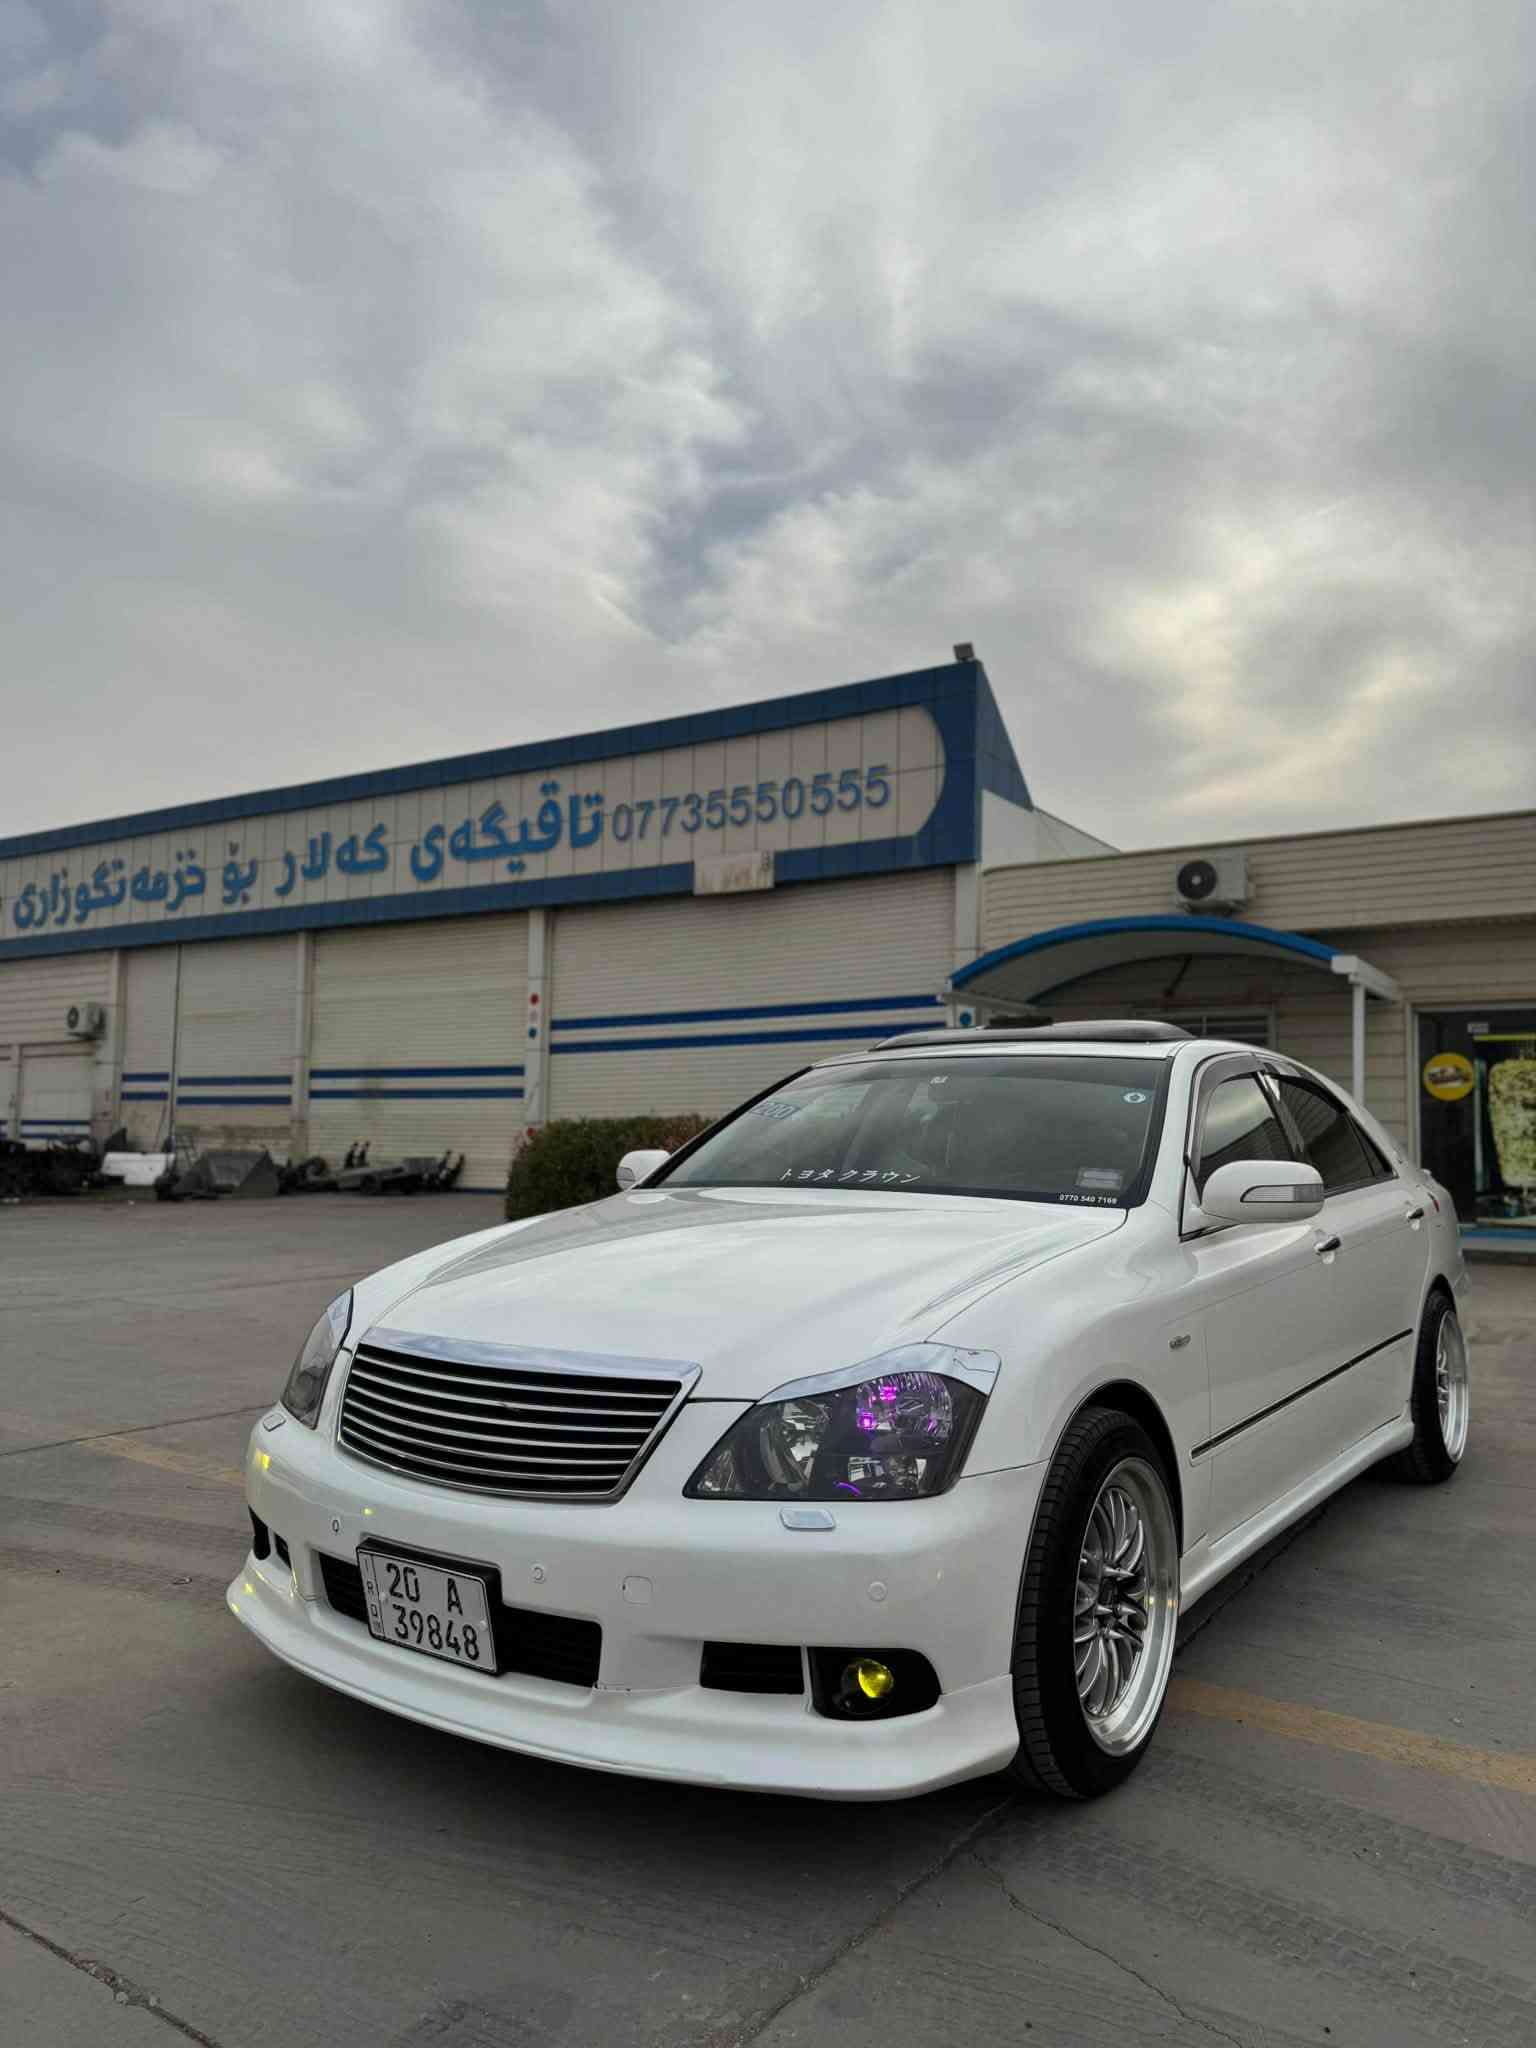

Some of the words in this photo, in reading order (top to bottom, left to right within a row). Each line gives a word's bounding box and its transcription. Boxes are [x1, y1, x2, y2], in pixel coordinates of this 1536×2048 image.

[611, 764, 892, 843] 07735550555
[387, 1563, 420, 1602] 20
[447, 1577, 464, 1617] A
[391, 1603, 480, 1661] 39848
